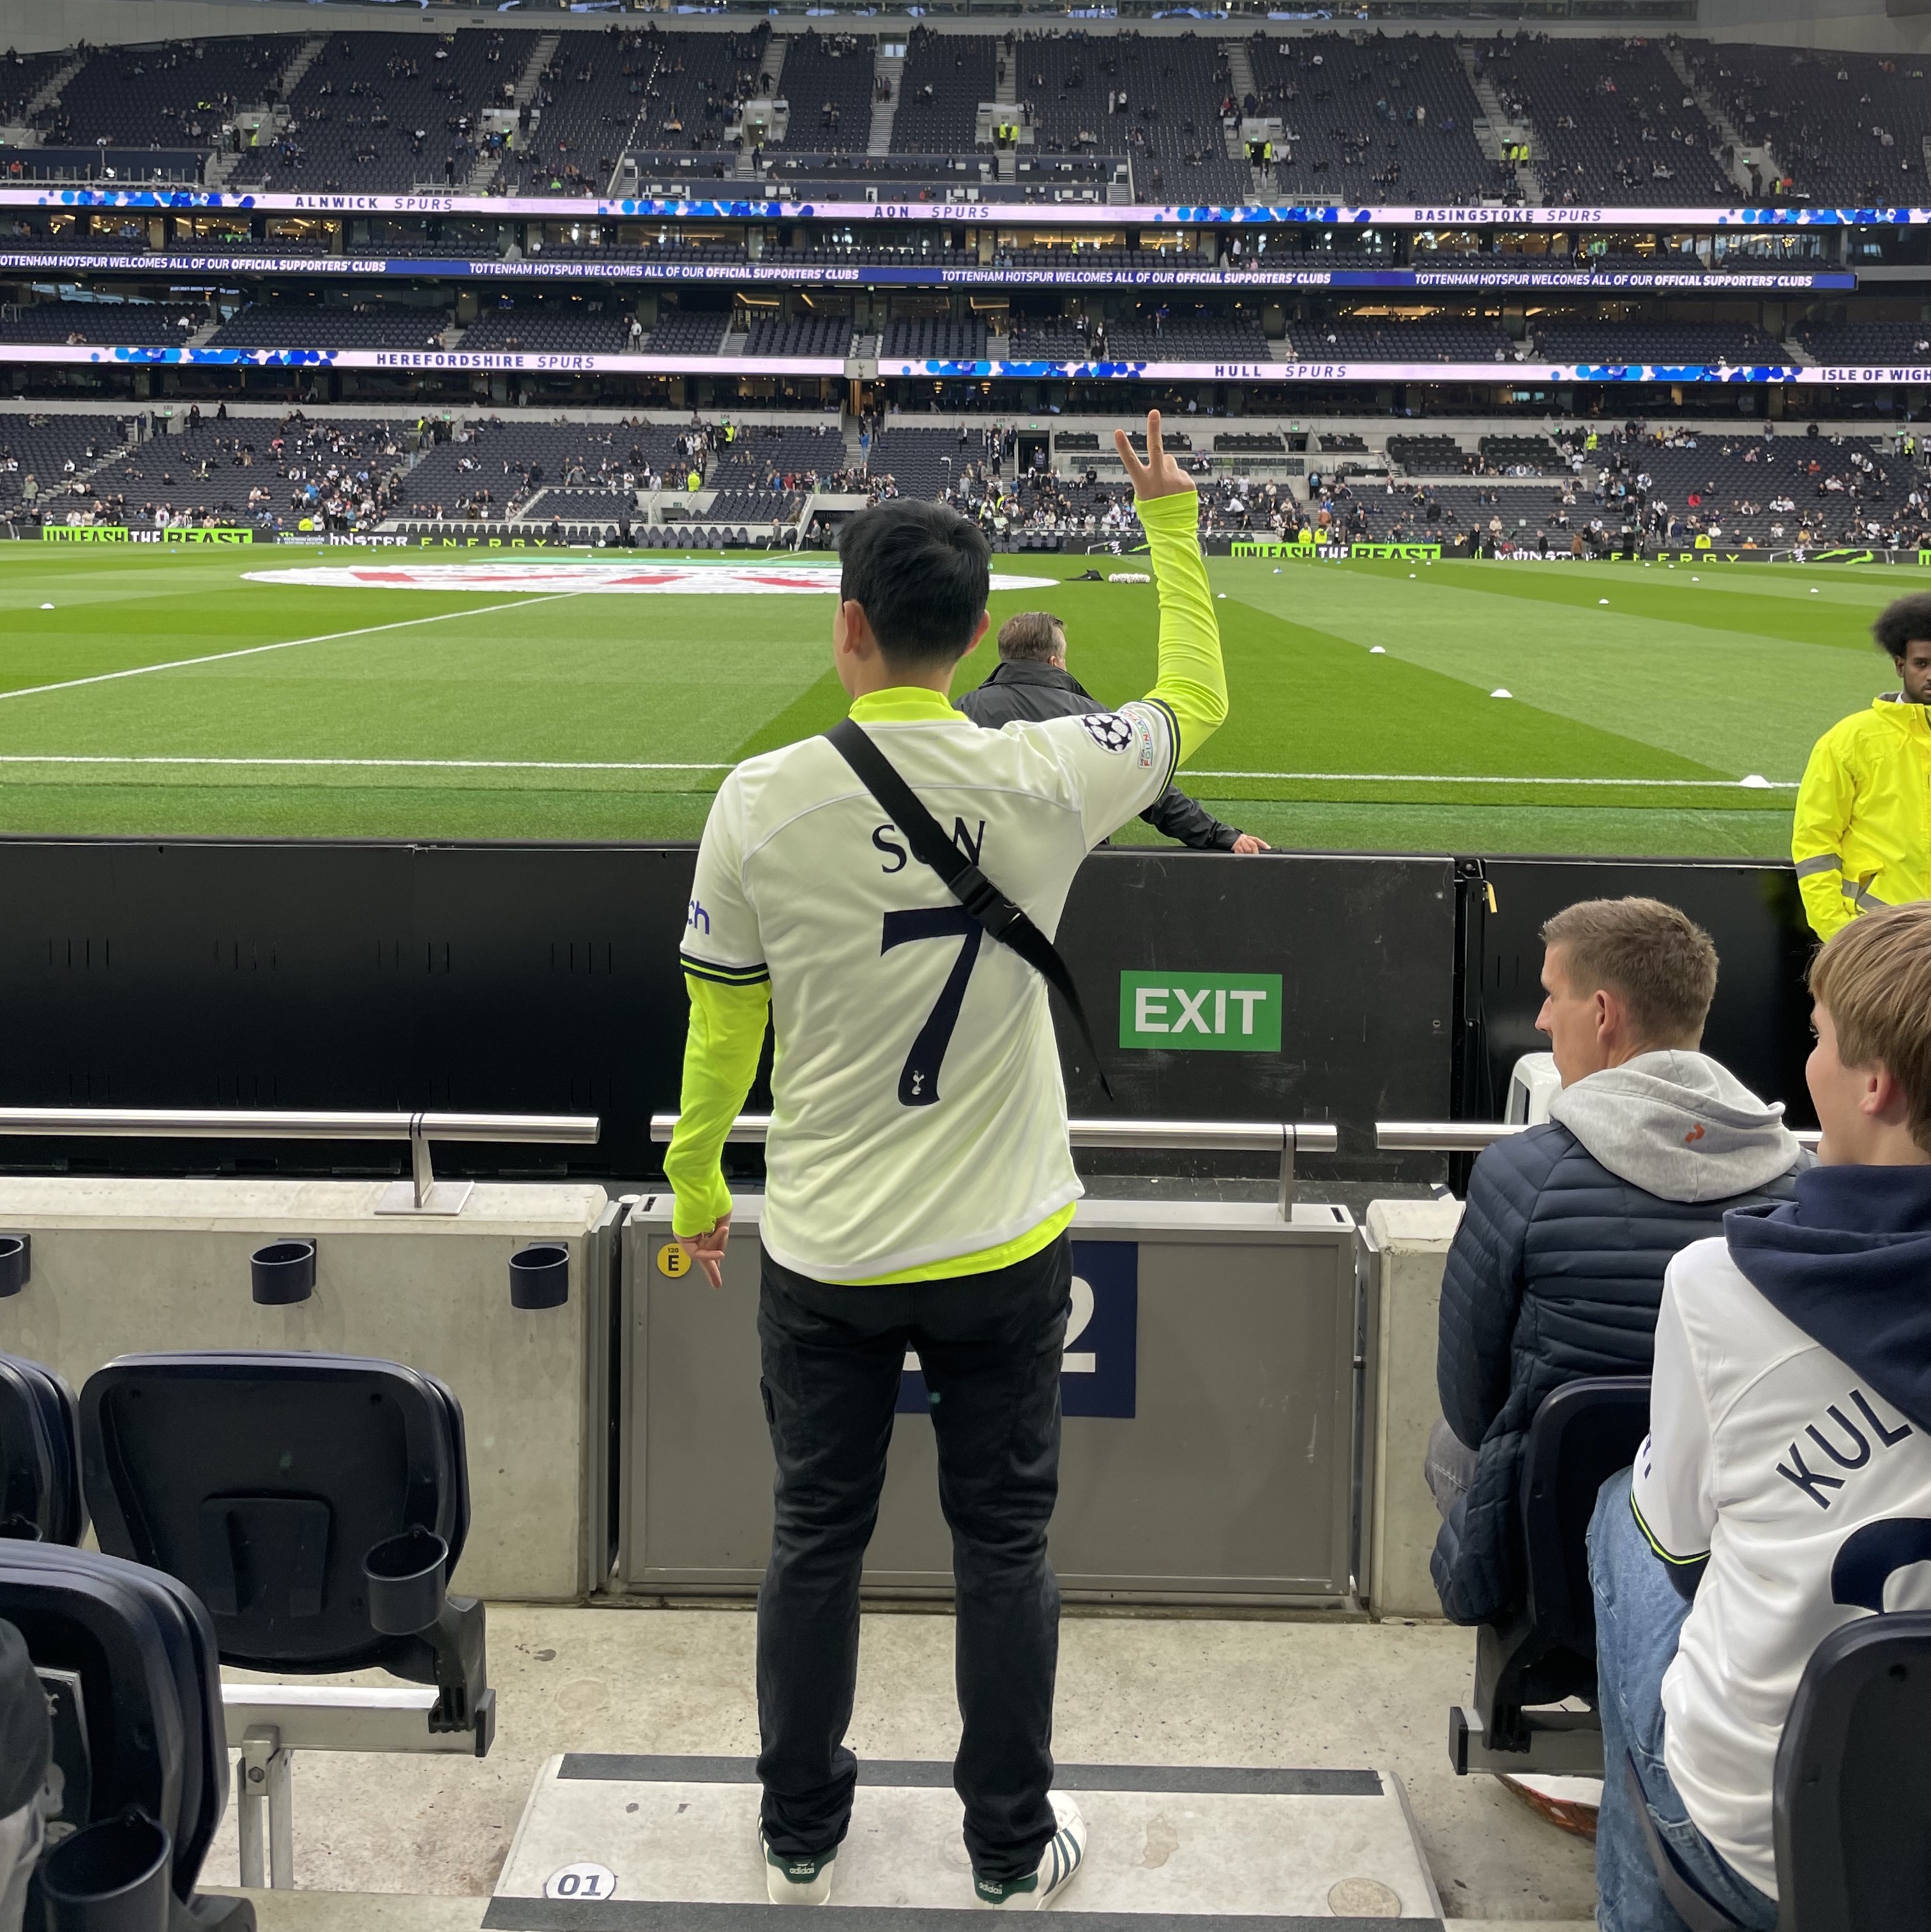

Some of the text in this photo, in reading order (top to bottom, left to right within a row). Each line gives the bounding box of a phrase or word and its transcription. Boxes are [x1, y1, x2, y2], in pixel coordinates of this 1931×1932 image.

[296, 197, 453, 210] ALNWICK SPURS
[874, 206, 989, 218] AON SPURS
[1414, 209, 1602, 222] BASINGSTOKE SPURS
[0, 255, 57, 267] OTTENHAM
[59, 256, 107, 267] HOTSPUR
[110, 257, 167, 268] WELCOMES
[169, 258, 189, 269] ALL
[192, 259, 205, 269] OF
[208, 259, 229, 270] OUR
[231, 259, 278, 270] OFFICIAL
[352, 261, 386, 272] CLUBS
[470, 263, 532, 275] TOTTENHAM
[534, 264, 582, 275] HOTSPUR
[584, 265, 642, 277] WELCOMES
[644, 266, 663, 277] ALL
[666, 266, 680, 277] OF
[682, 267, 703, 277] OUR
[706, 267, 752, 278] OFFICIAL
[825, 270, 859, 280] CLUBS
[942, 271, 1003, 282] TOTTENHAM
[1006, 271, 1054, 282] HOTSPUR
[1056, 272, 1113, 283] WELCOMES
[1115, 273, 1134, 283] ALL
[1136, 273, 1150, 283] OF
[1152, 273, 1174, 283] OUR
[1176, 273, 1222, 284] OFFICIAL
[1296, 273, 1331, 284] CLUBS
[1415, 273, 1478, 285] TOTTENHAM
[1480, 274, 1529, 285] HOTSPUR
[1532, 274, 1590, 285] WELCOMES
[1592, 275, 1612, 285] ALL
[1614, 275, 1628, 285] OF
[1630, 275, 1653, 285] OUR
[1655, 275, 1701, 286] OFFICIAL
[1778, 276, 1812, 287] CLUBS
[377, 354, 594, 369] HEREFORDSHIRE SPURS
[1215, 365, 1347, 377] HULL SPURS
[1822, 369, 1931, 381] ISLE OF WIGH
[47, 530, 249, 544] UNLEASH THE BEAST
[1234, 546, 1437, 559] UNLEASH THE BEAST
[872, 817, 985, 873] SN
[881, 904, 985, 1106] 7
[1135, 988, 1266, 1035] EXIT
[669, 1255, 679, 1271] E
[1775, 1389, 1914, 1510] KUL
[557, 1874, 602, 1896] 01
